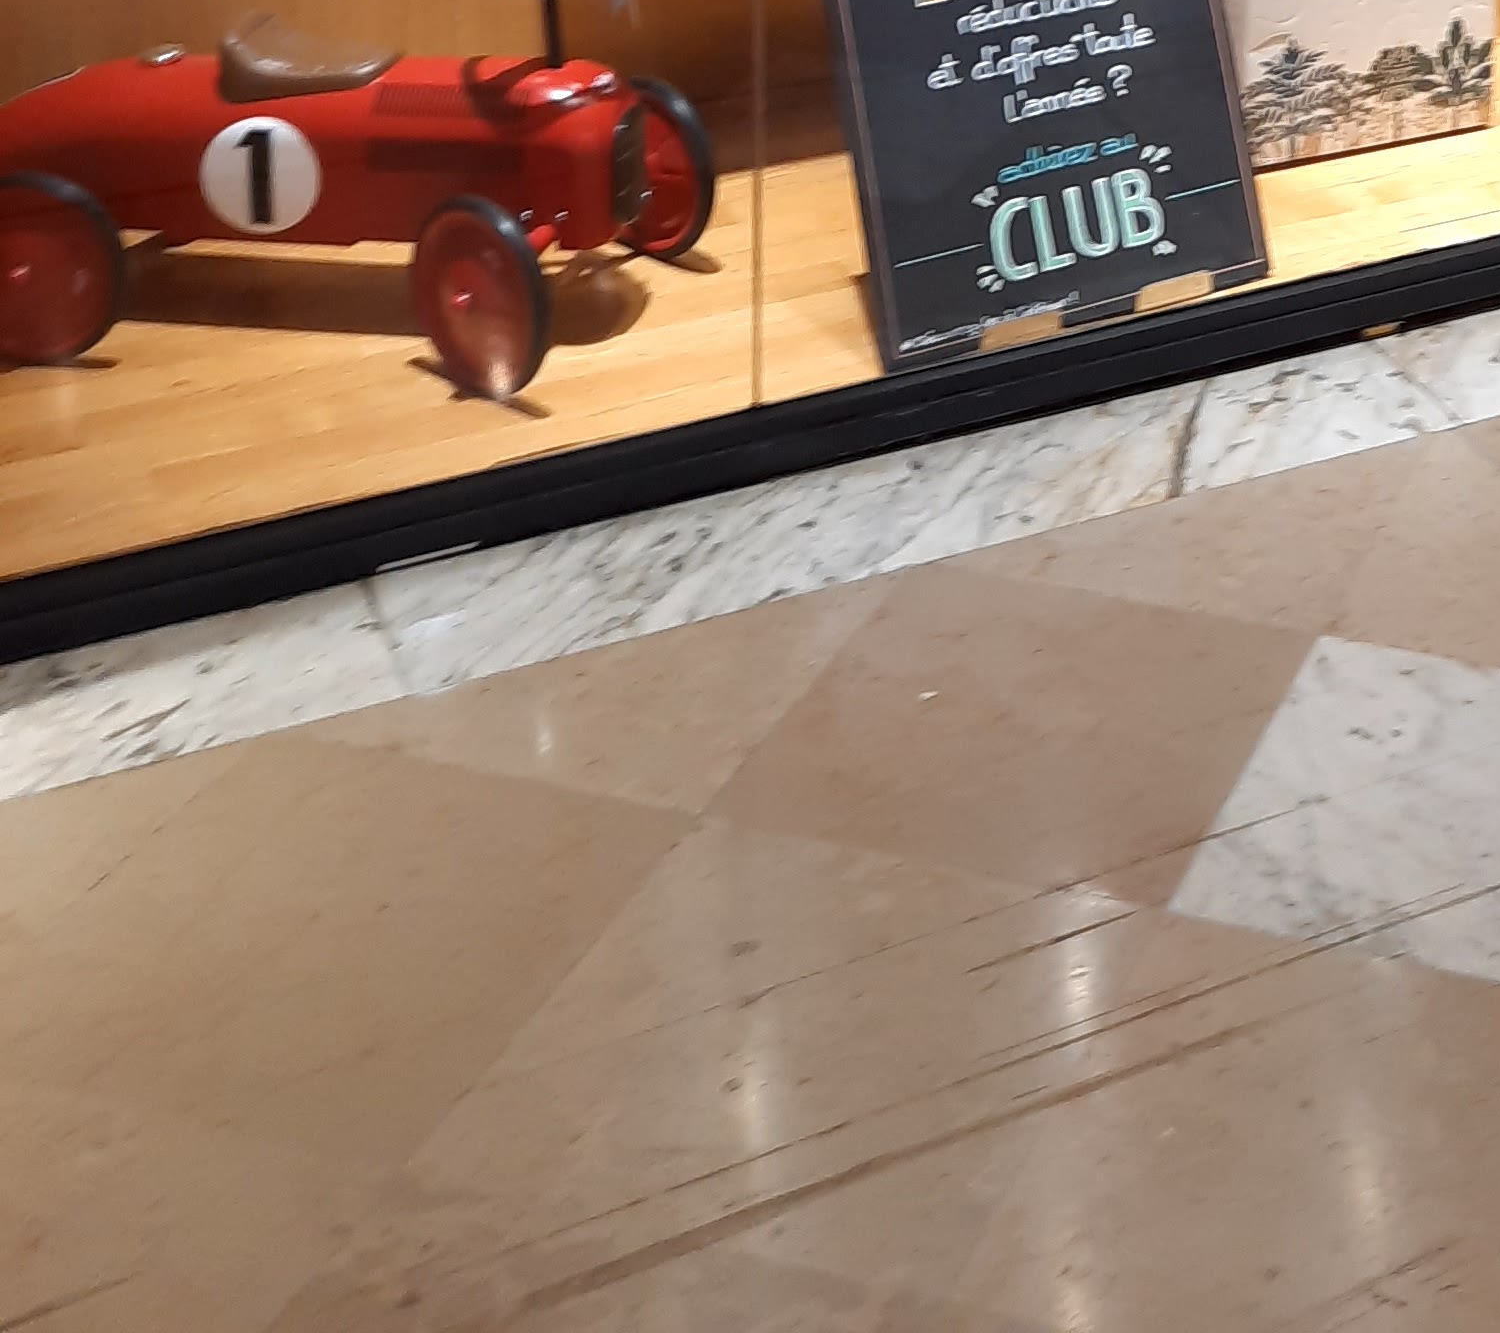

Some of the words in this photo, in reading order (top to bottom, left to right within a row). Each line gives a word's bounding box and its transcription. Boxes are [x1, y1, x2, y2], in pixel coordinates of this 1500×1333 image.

[926, 53, 965, 90] et
[970, 34, 1081, 86] d'offres
[1069, 12, 1157, 56] toute
[1106, 63, 1134, 97] ?
[233, 128, 275, 225] 1
[989, 168, 1166, 282] CLUB
